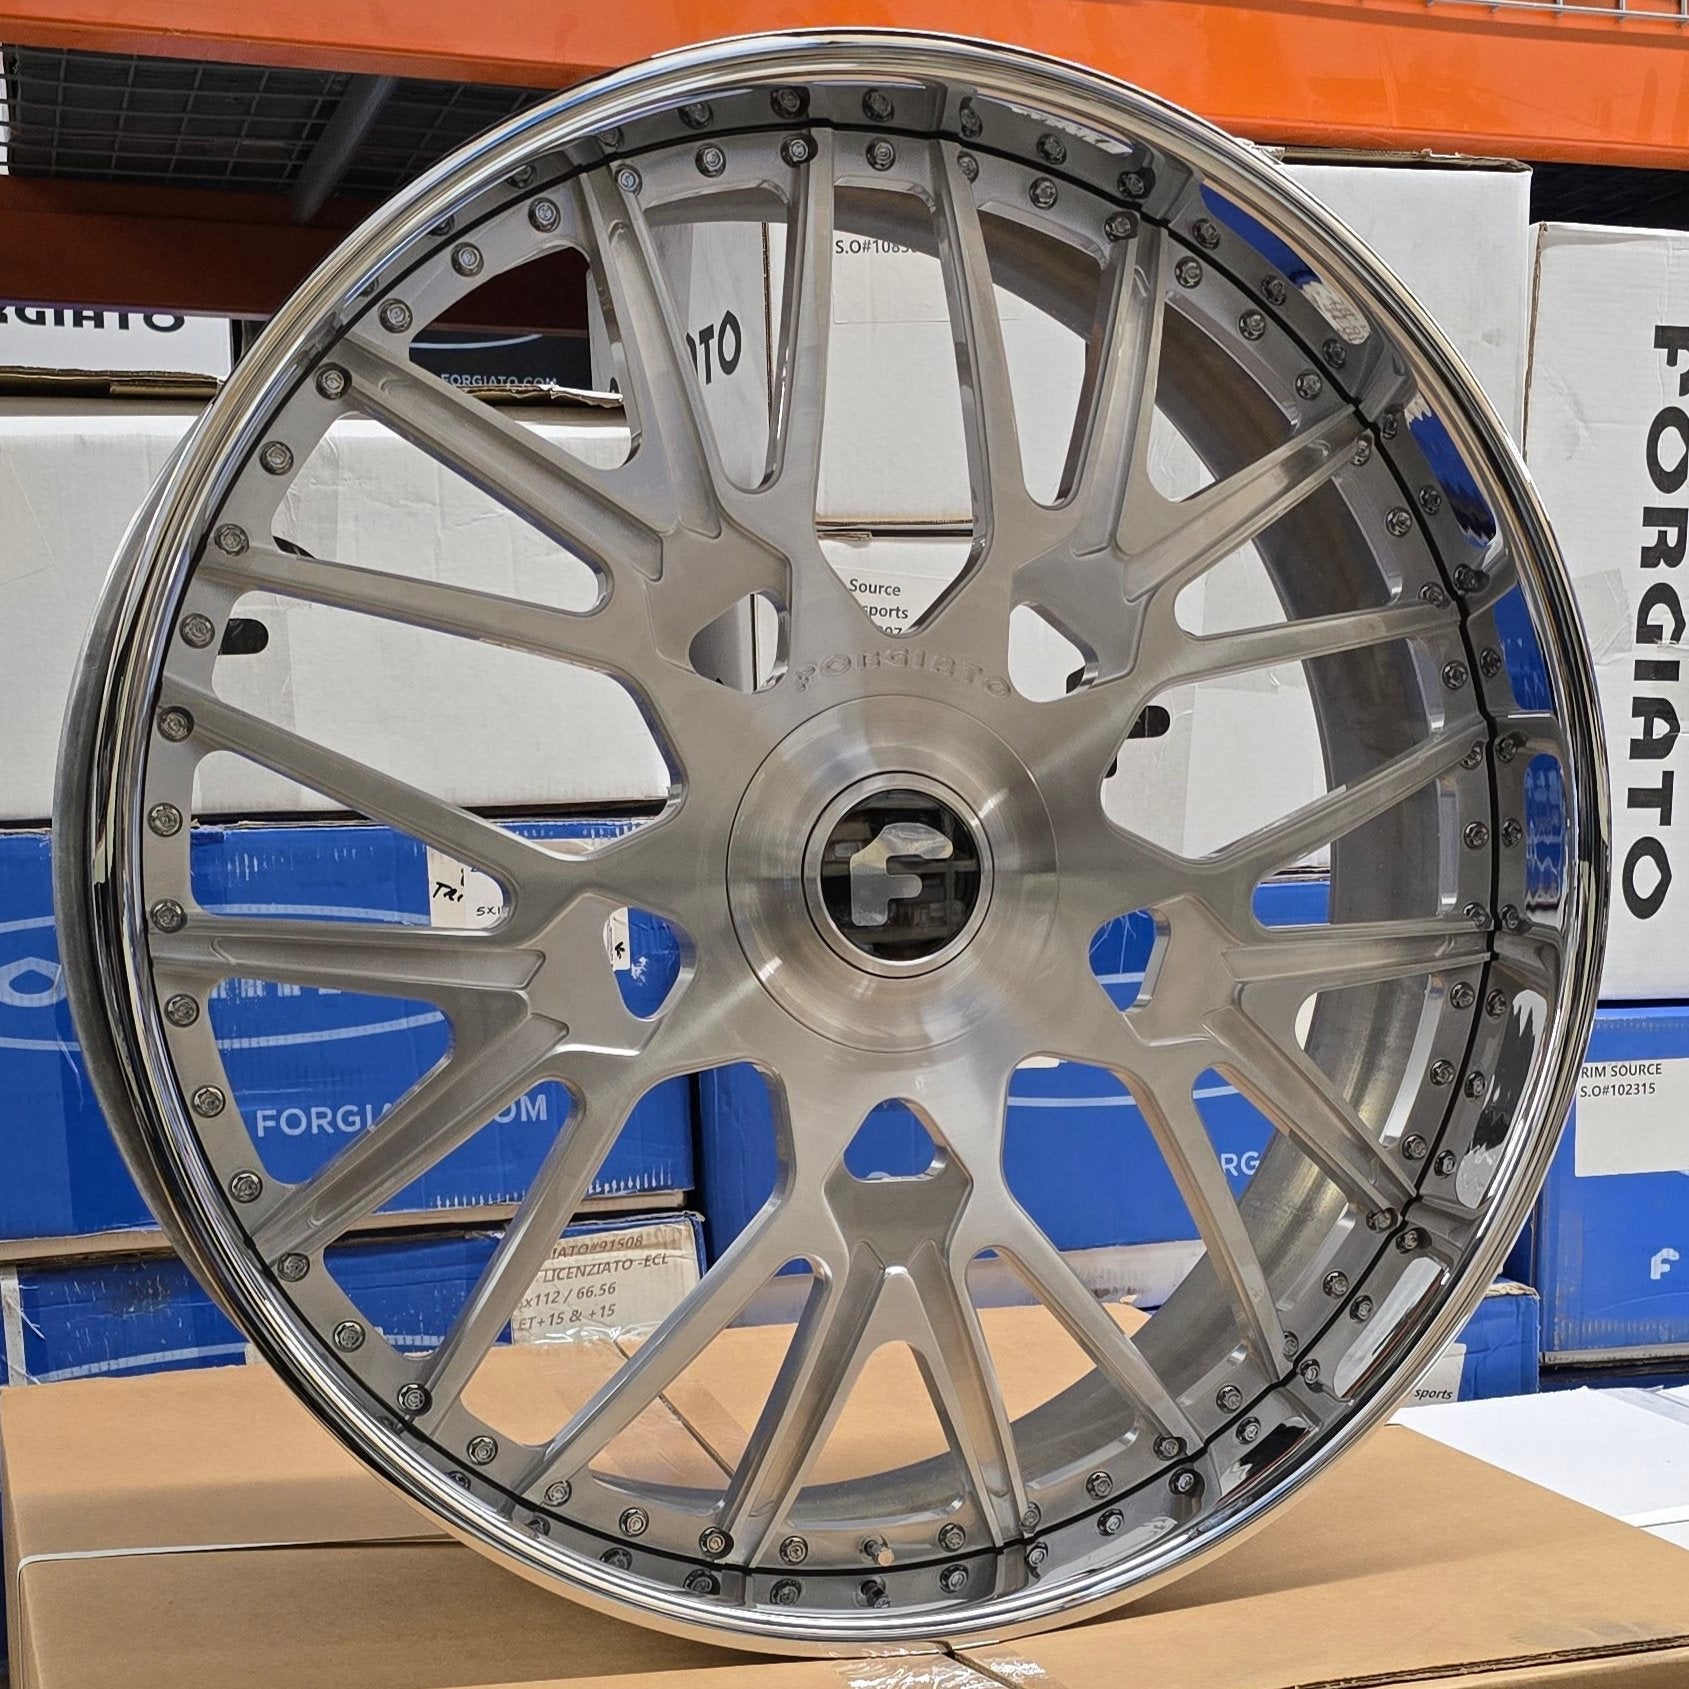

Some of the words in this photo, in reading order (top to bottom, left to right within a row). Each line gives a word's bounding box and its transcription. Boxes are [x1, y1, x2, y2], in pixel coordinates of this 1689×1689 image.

[0, 306, 185, 333] GIATO
[848, 578, 901, 596] Source
[1621, 325, 1689, 920] FORGIATO
[796, 648, 1012, 698] FORGIATO
[1581, 1065, 1606, 1078] RIM
[1611, 1063, 1662, 1077] SOURCE
[1580, 1082, 1656, 1097] S.O#102315
[576, 1282, 617, 1300] 66.56
[588, 1304, 616, 1320] +15
[1414, 1389, 1453, 1400] sports
